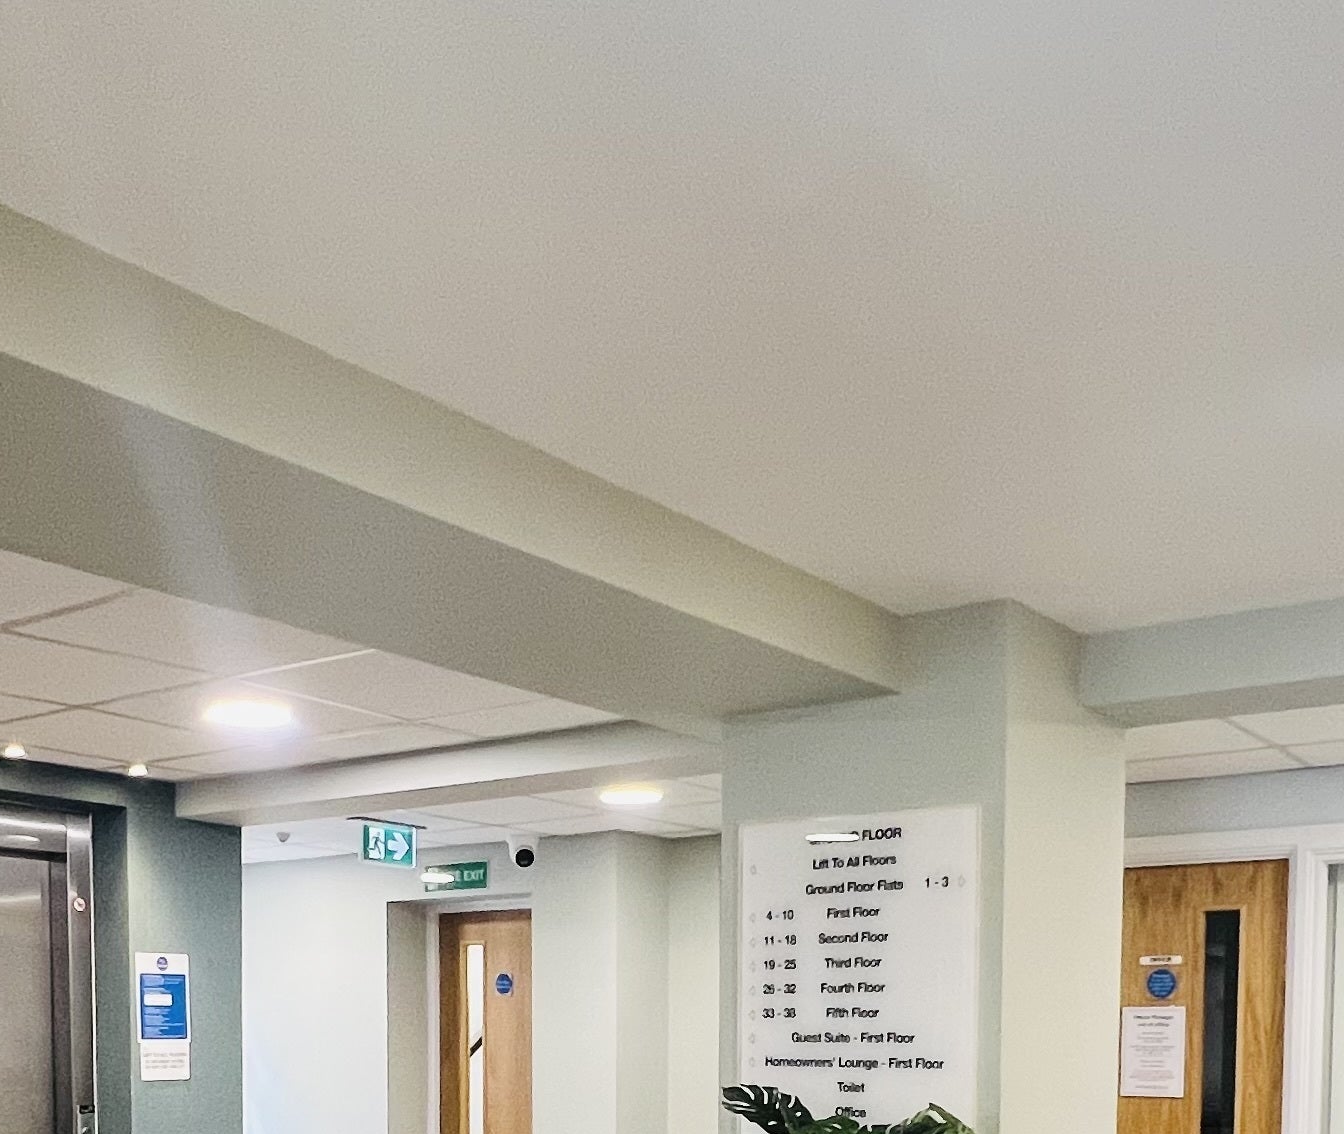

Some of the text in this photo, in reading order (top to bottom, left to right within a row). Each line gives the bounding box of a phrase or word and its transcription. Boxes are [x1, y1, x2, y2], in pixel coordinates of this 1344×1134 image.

[862, 827, 902, 841] FLOOR
[813, 855, 896, 870] Lift To All Floors
[463, 869, 485, 882] EXIT
[805, 879, 903, 895] Ground Floor Flats
[925, 877, 931, 889] 1
[941, 876, 949, 888] 3
[766, 911, 773, 921] 4
[782, 909, 794, 920] 10
[827, 906, 879, 919] First Floor
[764, 936, 775, 946] 11
[784, 934, 797, 945] 18
[818, 931, 888, 944] Second Floor
[764, 959, 776, 970] 19
[784, 959, 797, 969] 25
[824, 956, 881, 969] Third Floor
[762, 983, 775, 995] 26
[783, 983, 797, 994] 32
[820, 982, 885, 994] Fourth Floor
[762, 1008, 775, 1019] 33
[825, 1007, 879, 1018] Fifth Floor
[791, 1032, 822, 1043] Guest
[824, 1032, 851, 1043] Suite
[860, 1032, 883, 1043] First
[886, 1032, 915, 1043] Floor
[765, 1057, 836, 1068] Homeowners'
[838, 1056, 878, 1070] Lounge
[888, 1057, 912, 1069] First
[915, 1057, 943, 1069] Floor
[837, 1081, 865, 1093] Toilet
[835, 1106, 866, 1118] Office
